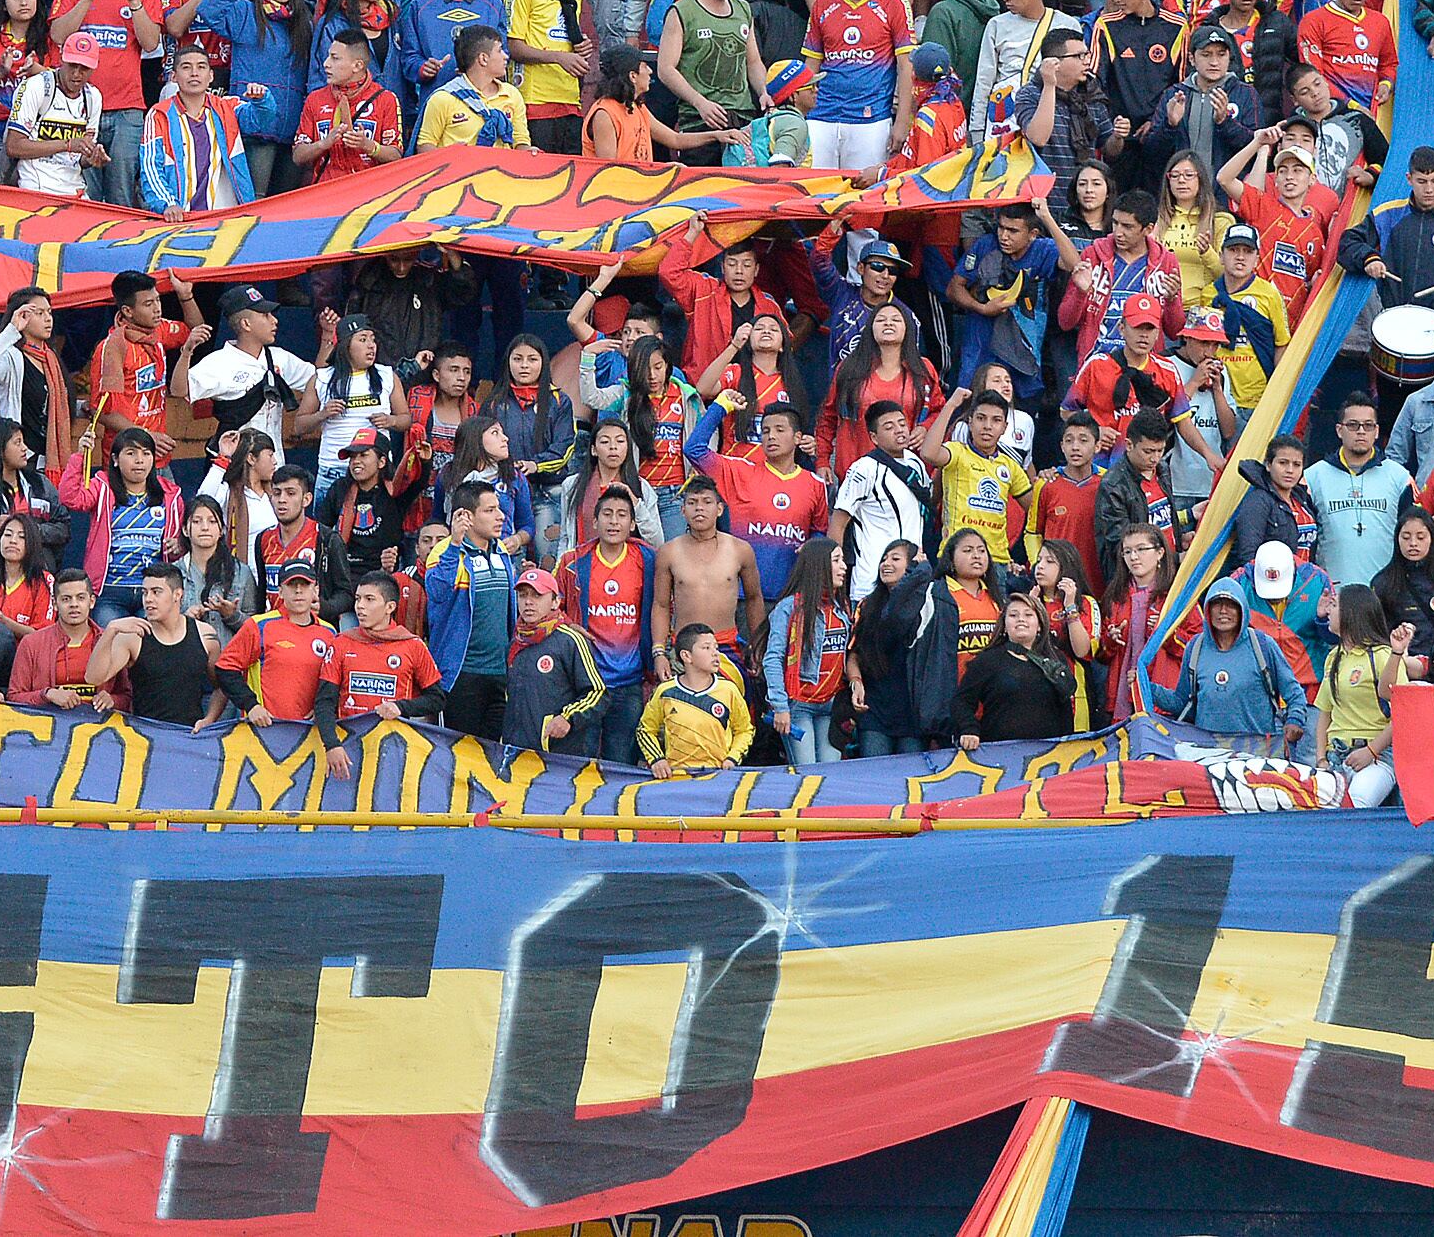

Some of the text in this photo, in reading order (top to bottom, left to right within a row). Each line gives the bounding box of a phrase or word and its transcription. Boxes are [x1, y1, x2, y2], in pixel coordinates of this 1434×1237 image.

[747, 521, 806, 542] NARIÑO
[588, 602, 636, 617] NARIÑO
[352, 677, 394, 691] NARIÑO
